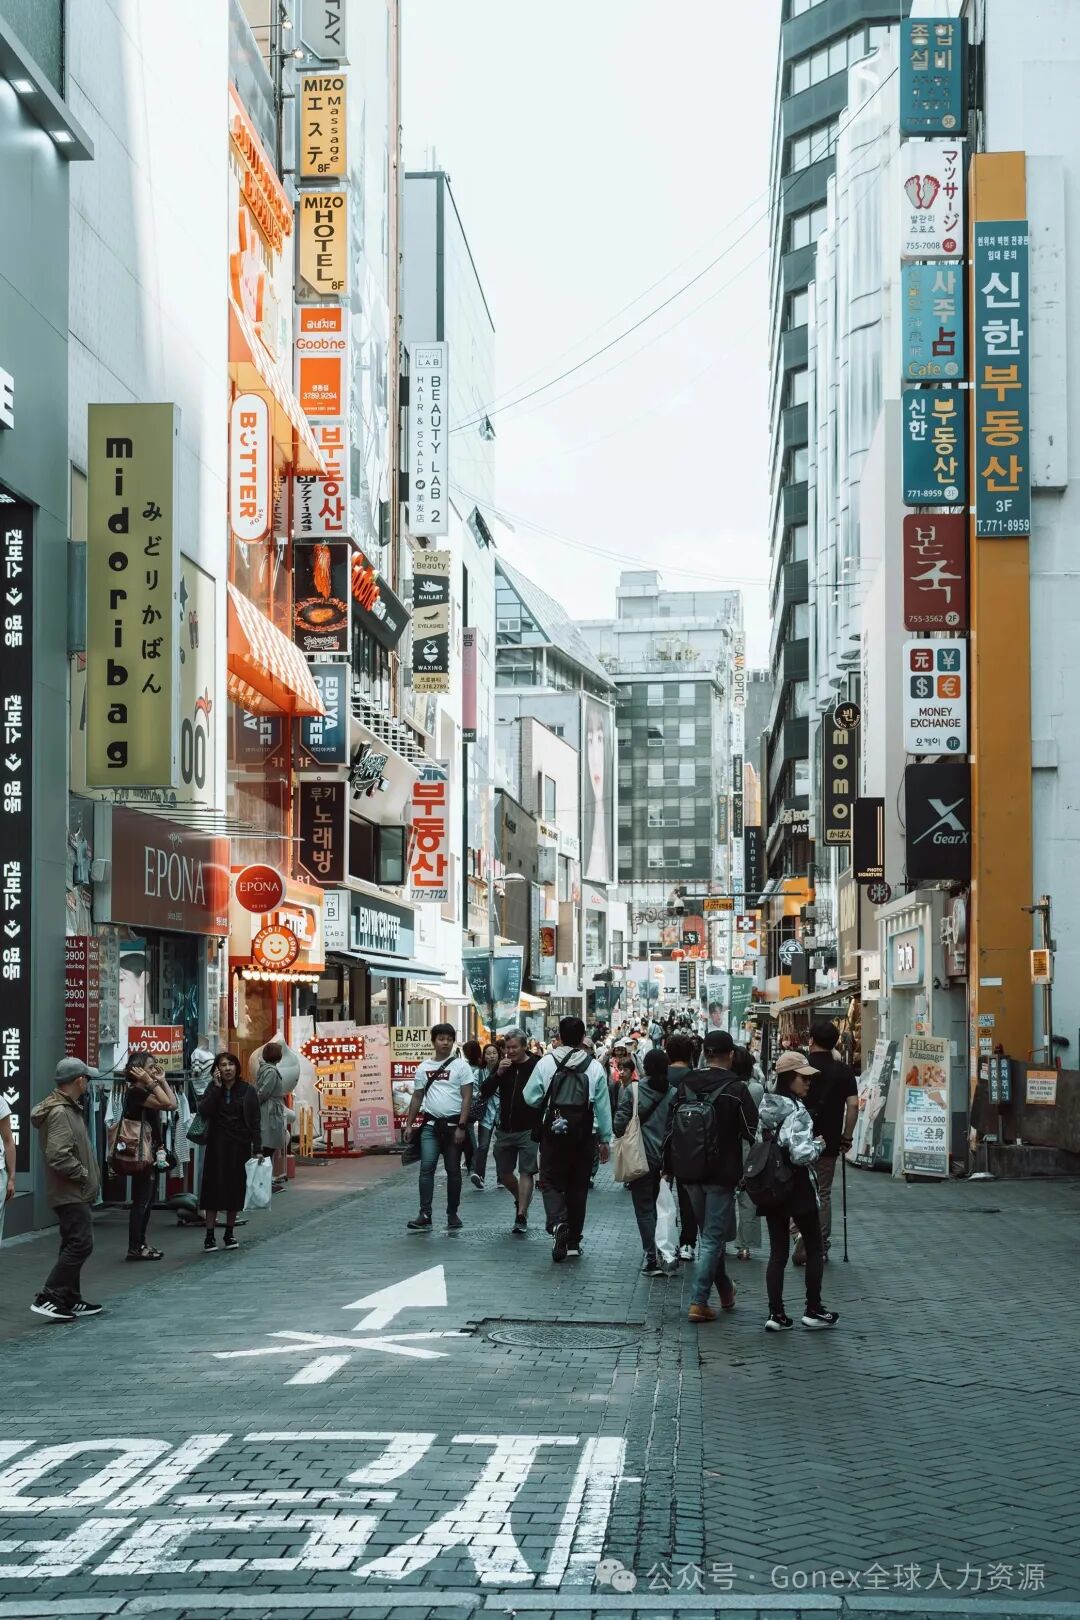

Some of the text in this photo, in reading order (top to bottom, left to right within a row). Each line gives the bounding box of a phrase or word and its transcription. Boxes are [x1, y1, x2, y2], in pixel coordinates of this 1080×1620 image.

[910, 24, 953, 45] 종합
[910, 49, 952, 71] 설비
[304, 79, 344, 91] MIZO
[307, 97, 323, 165] エステ
[327, 97, 341, 163] Massage
[317, 164, 330, 173] 8F
[942, 150, 959, 232] マッサージ
[304, 197, 344, 208] MIZO
[313, 210, 335, 281] HOTEL
[332, 281, 344, 290] 8F
[931, 271, 956, 356] 사주점
[296, 338, 346, 350] Goobne
[980, 272, 1023, 492] 신한 부동산
[908, 399, 928, 440] 신한
[431, 376, 441, 523] BEAUTY LAB 2
[931, 399, 958, 483] 부동산
[996, 500, 1012, 512] 3F
[977, 519, 1029, 532] T.771-8959
[416, 562, 446, 571] Beauty
[910, 525, 962, 603] 본죽
[5, 529, 23, 648] 컨버스 명동
[105, 437, 133, 769] midoribag
[141, 501, 162, 695] みどりかばん
[908, 615, 944, 623] 755-3562
[948, 614, 957, 622] 2F
[919, 707, 952, 716] MONEY
[910, 718, 961, 727] EXCHANGE
[4, 694, 22, 814] 컨버스 명동
[298, 757, 311, 768] 1F
[832, 729, 849, 819] momo
[310, 787, 336, 802] 루키
[312, 804, 334, 874] 노래방
[412, 782, 448, 887] 부동산
[144, 846, 207, 905] EPONA
[240, 881, 279, 892] EPONA
[411, 888, 447, 899] 777-7727
[3, 861, 21, 981] 컨버스 명동
[260, 957, 292, 968] BUTTER
[141, 1030, 158, 1038] ALL
[405, 1030, 428, 1041] AZIT
[2, 1027, 20, 1078] 컨버스
[311, 1045, 357, 1054] BUTTER
[908, 1039, 944, 1053] Hikari
[909, 1050, 945, 1063] Massage
[905, 1090, 924, 1107] 足
